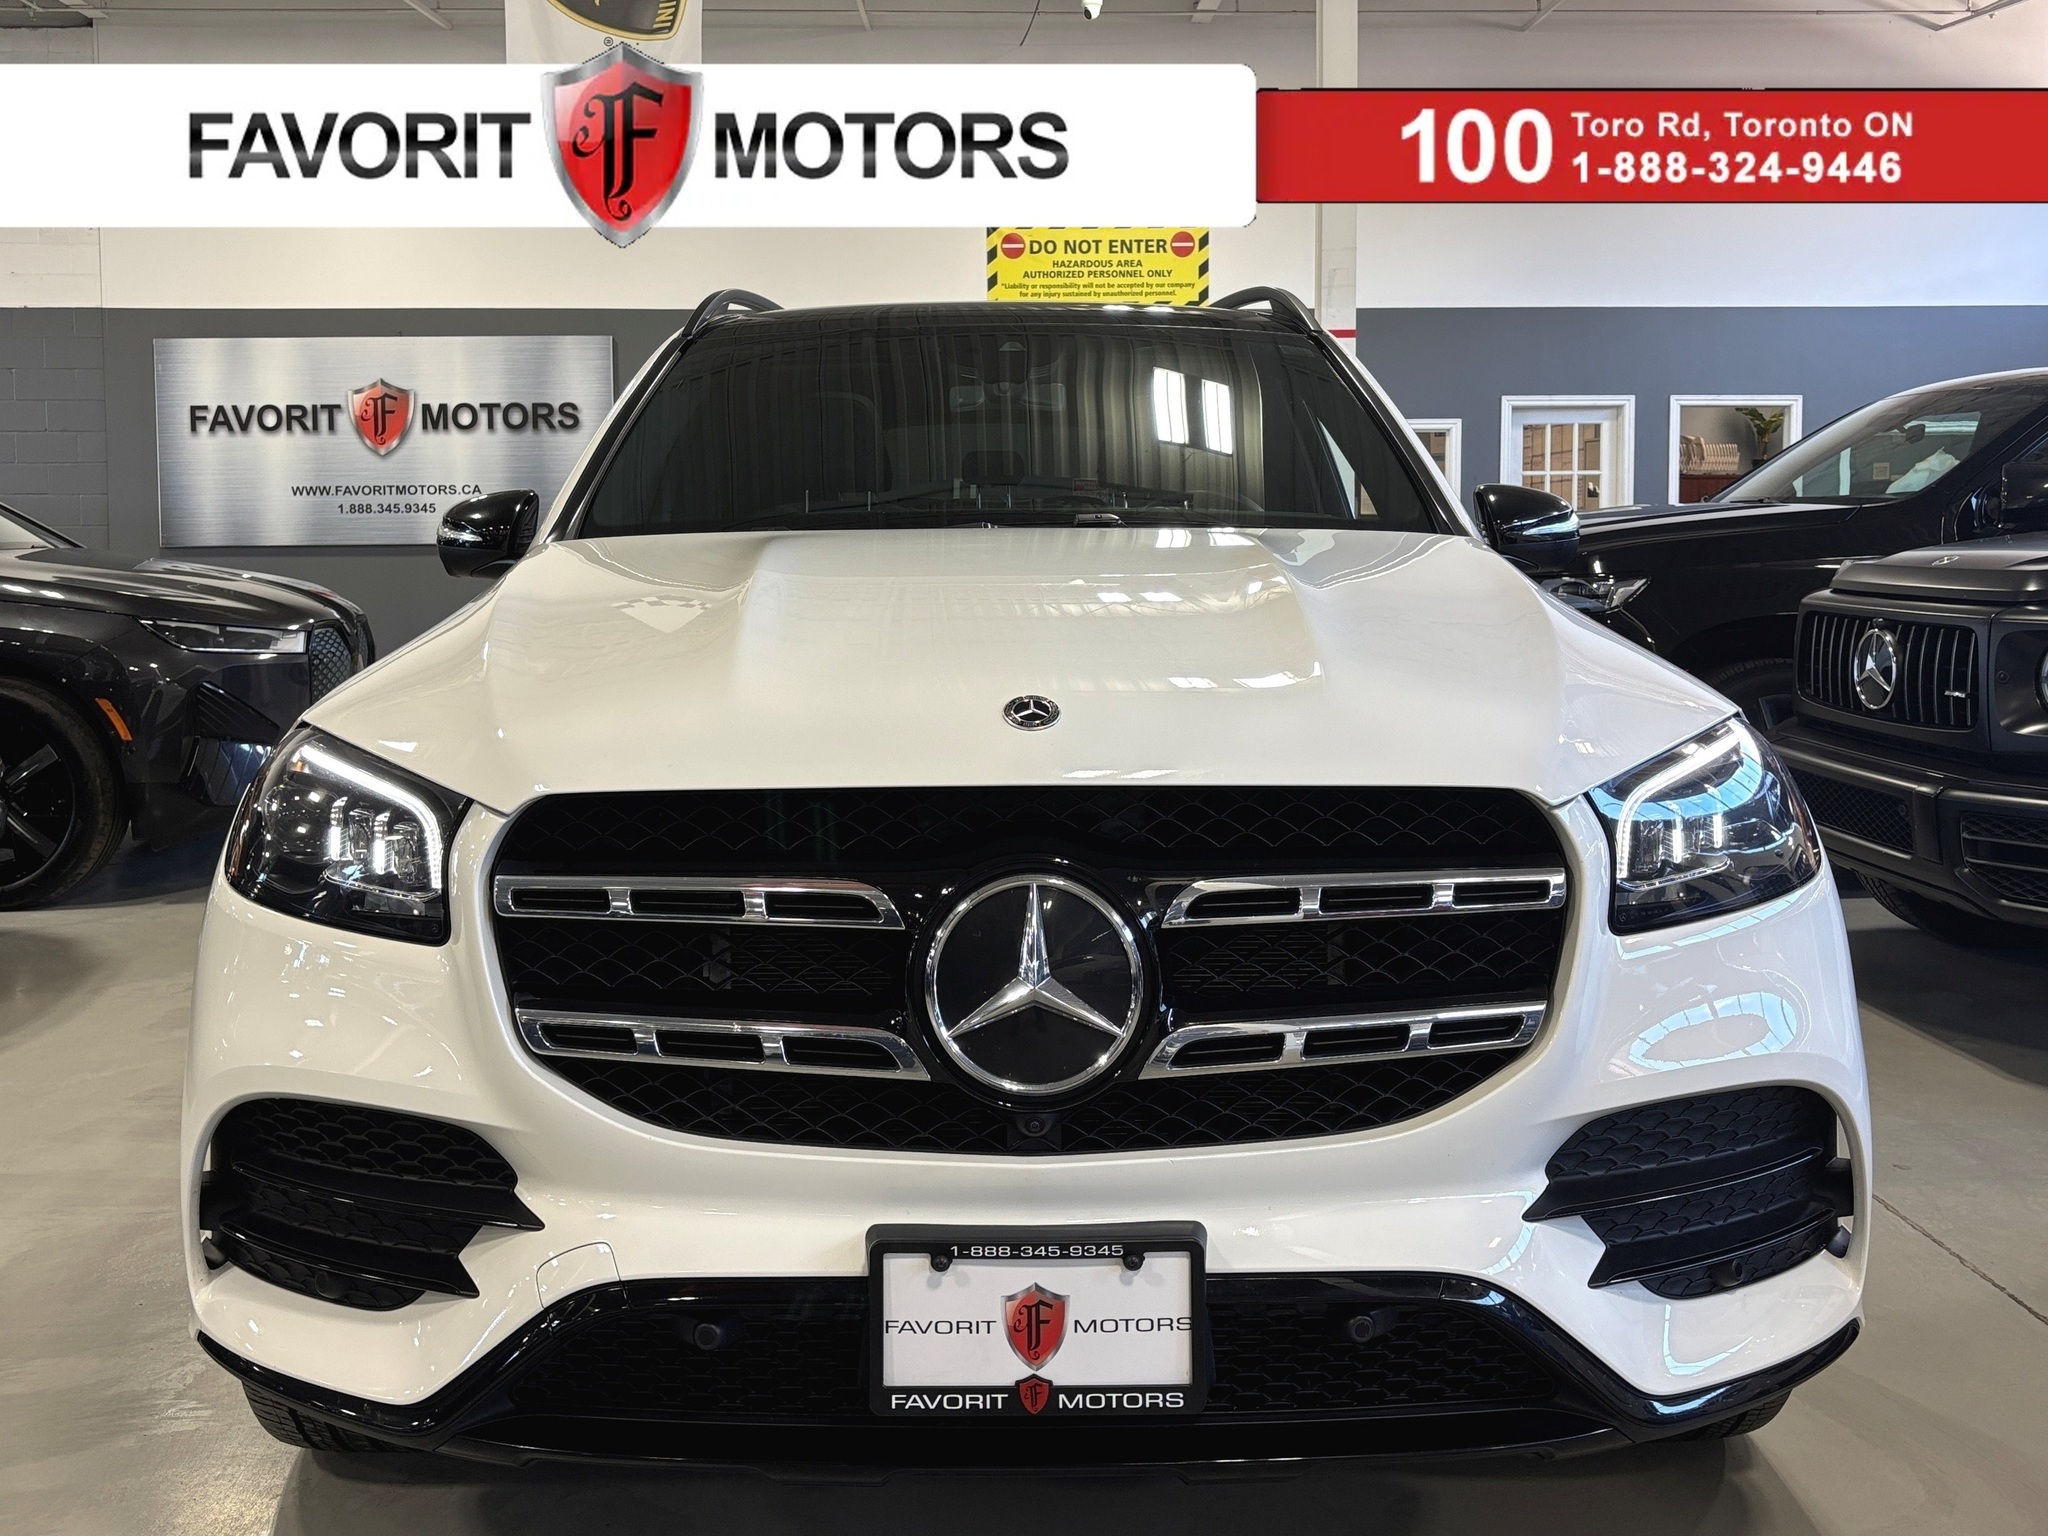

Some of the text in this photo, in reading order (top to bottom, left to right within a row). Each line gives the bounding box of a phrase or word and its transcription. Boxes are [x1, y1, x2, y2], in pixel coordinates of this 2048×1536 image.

[1029, 238, 1168, 255] DO NOT ENTER
[1052, 259, 1143, 269] HAZARDOUS AREA
[1022, 269, 1173, 279] AUTHORIZED PERSONNEL ONLY
[1039, 282, 1081, 291] responsibility
[1117, 281, 1145, 290] accepted
[1145, 281, 1154, 290] by
[1167, 282, 1196, 290] company
[1019, 290, 1029, 298] for
[1042, 290, 1061, 299] injury
[1062, 290, 1092, 298] sustained
[1092, 290, 1101, 299] by
[1102, 290, 1144, 298] unauthorized
[189, 404, 342, 433] FAVORIT
[421, 402, 580, 431] MOTORS
[291, 484, 483, 498] WWW.FAVORITMOTORS.CA
[337, 502, 437, 515] 1.888.345.9345
[950, 1244, 1124, 1258] 1-888-345-9345
[885, 1319, 997, 1336] FAVORIT
[1074, 1316, 1193, 1334] MOTORS
[891, 1394, 1009, 1411] FAVORIT
[1058, 1392, 1185, 1410] MOTORS
